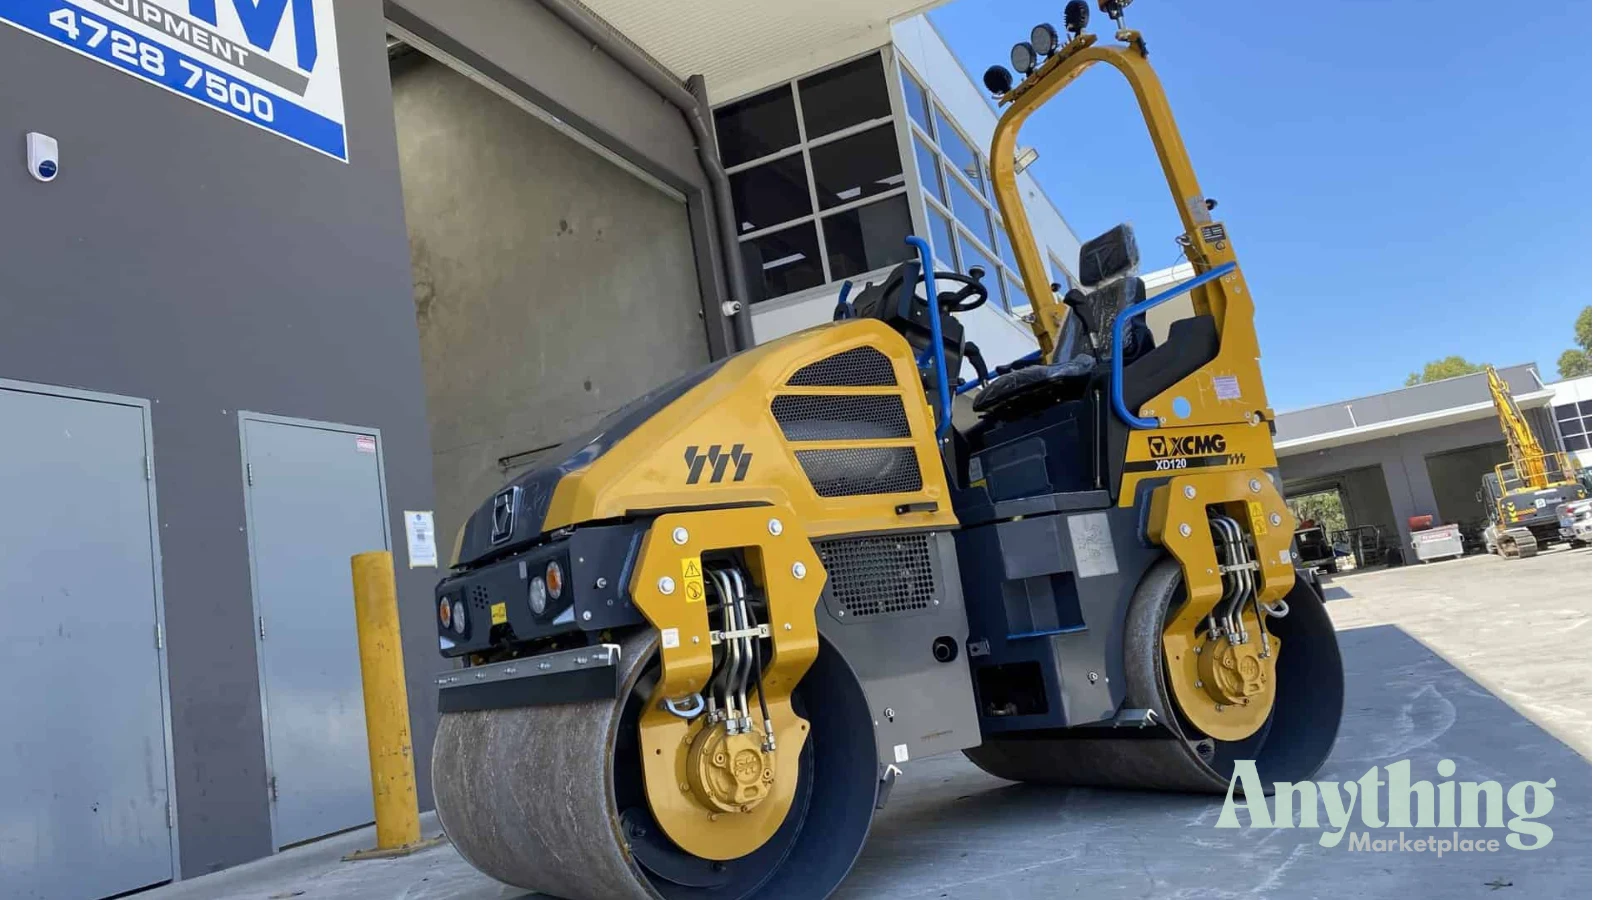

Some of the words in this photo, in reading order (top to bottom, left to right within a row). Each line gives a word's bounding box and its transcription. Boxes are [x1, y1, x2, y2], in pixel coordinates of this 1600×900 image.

[48, 8, 165, 77] 4728
[179, 59, 274, 122] 7500
[1168, 434, 1226, 457] XCMG
[1155, 458, 1187, 472] XD120
